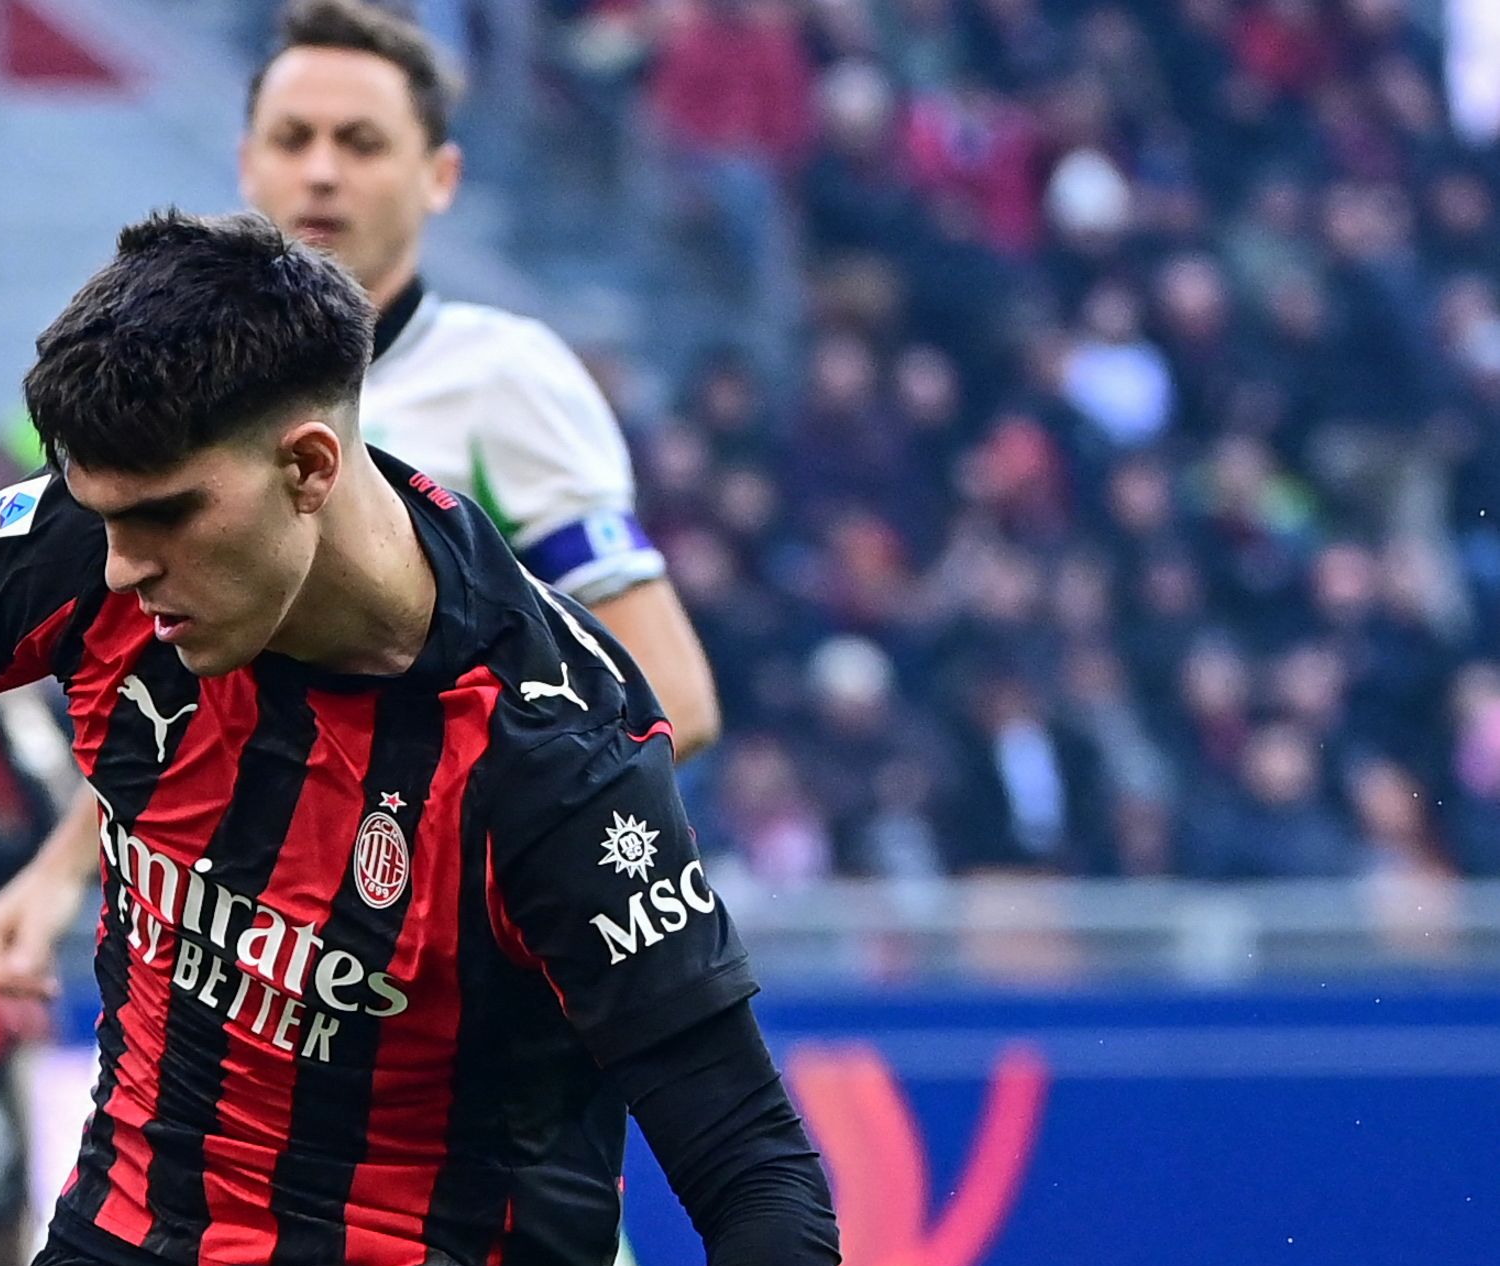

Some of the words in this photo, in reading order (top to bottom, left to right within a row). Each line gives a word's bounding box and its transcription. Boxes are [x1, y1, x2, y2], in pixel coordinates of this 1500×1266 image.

[364, 877, 390, 898] 1899
[588, 859, 716, 966] MSC
[172, 938, 341, 1064] BETTER
